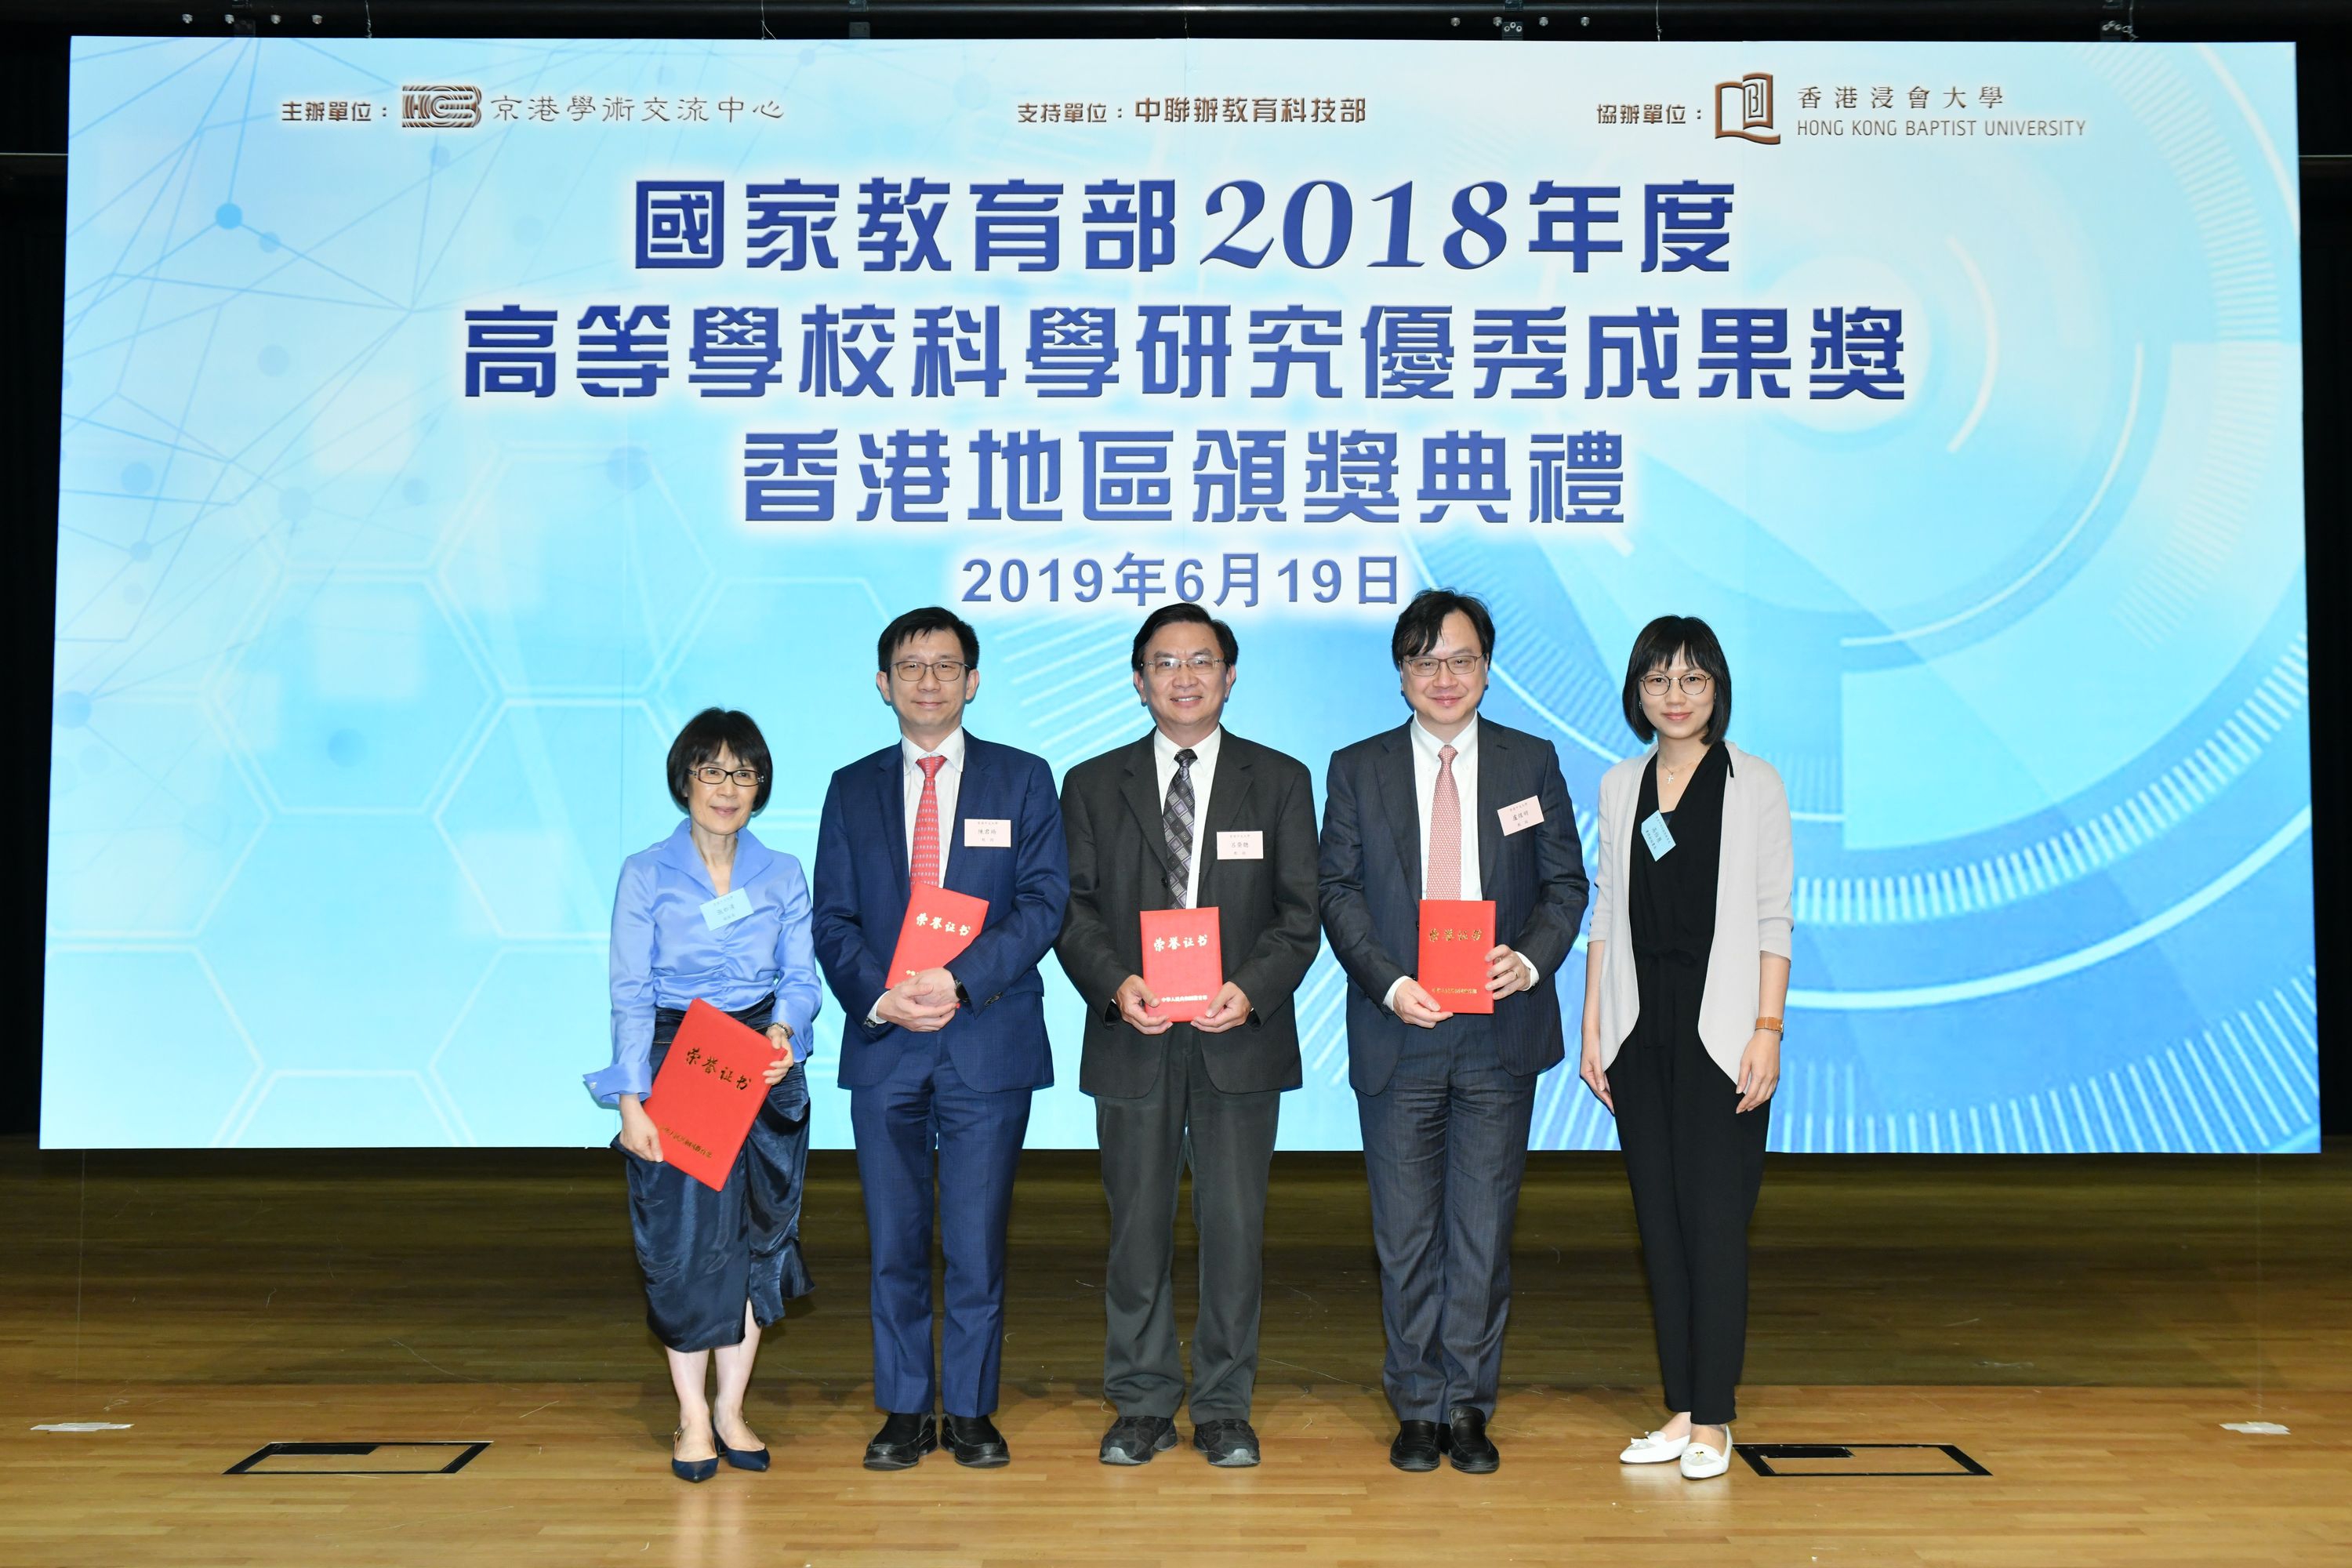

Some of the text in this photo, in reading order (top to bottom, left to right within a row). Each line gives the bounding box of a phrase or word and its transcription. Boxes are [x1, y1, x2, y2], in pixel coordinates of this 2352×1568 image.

[281, 101, 387, 122] 主辦單位：
[490, 95, 784, 123] 京港學術交流中心
[1018, 96, 1366, 123] 支持單位： 中聯辦教育科技部
[1798, 85, 2004, 109] 香港浸會大學
[1596, 103, 1701, 125] 協辦單位：
[1797, 119, 2086, 136] HONG KONG BAPTIST UNIVERSITY
[634, 176, 1735, 274] 國家教育部2018年度
[464, 303, 1905, 401] 高等學校科學研究優秀成果獎
[744, 428, 1624, 524] 香港地區頒獎典禮
[961, 551, 1398, 608] 2019年6月19日
